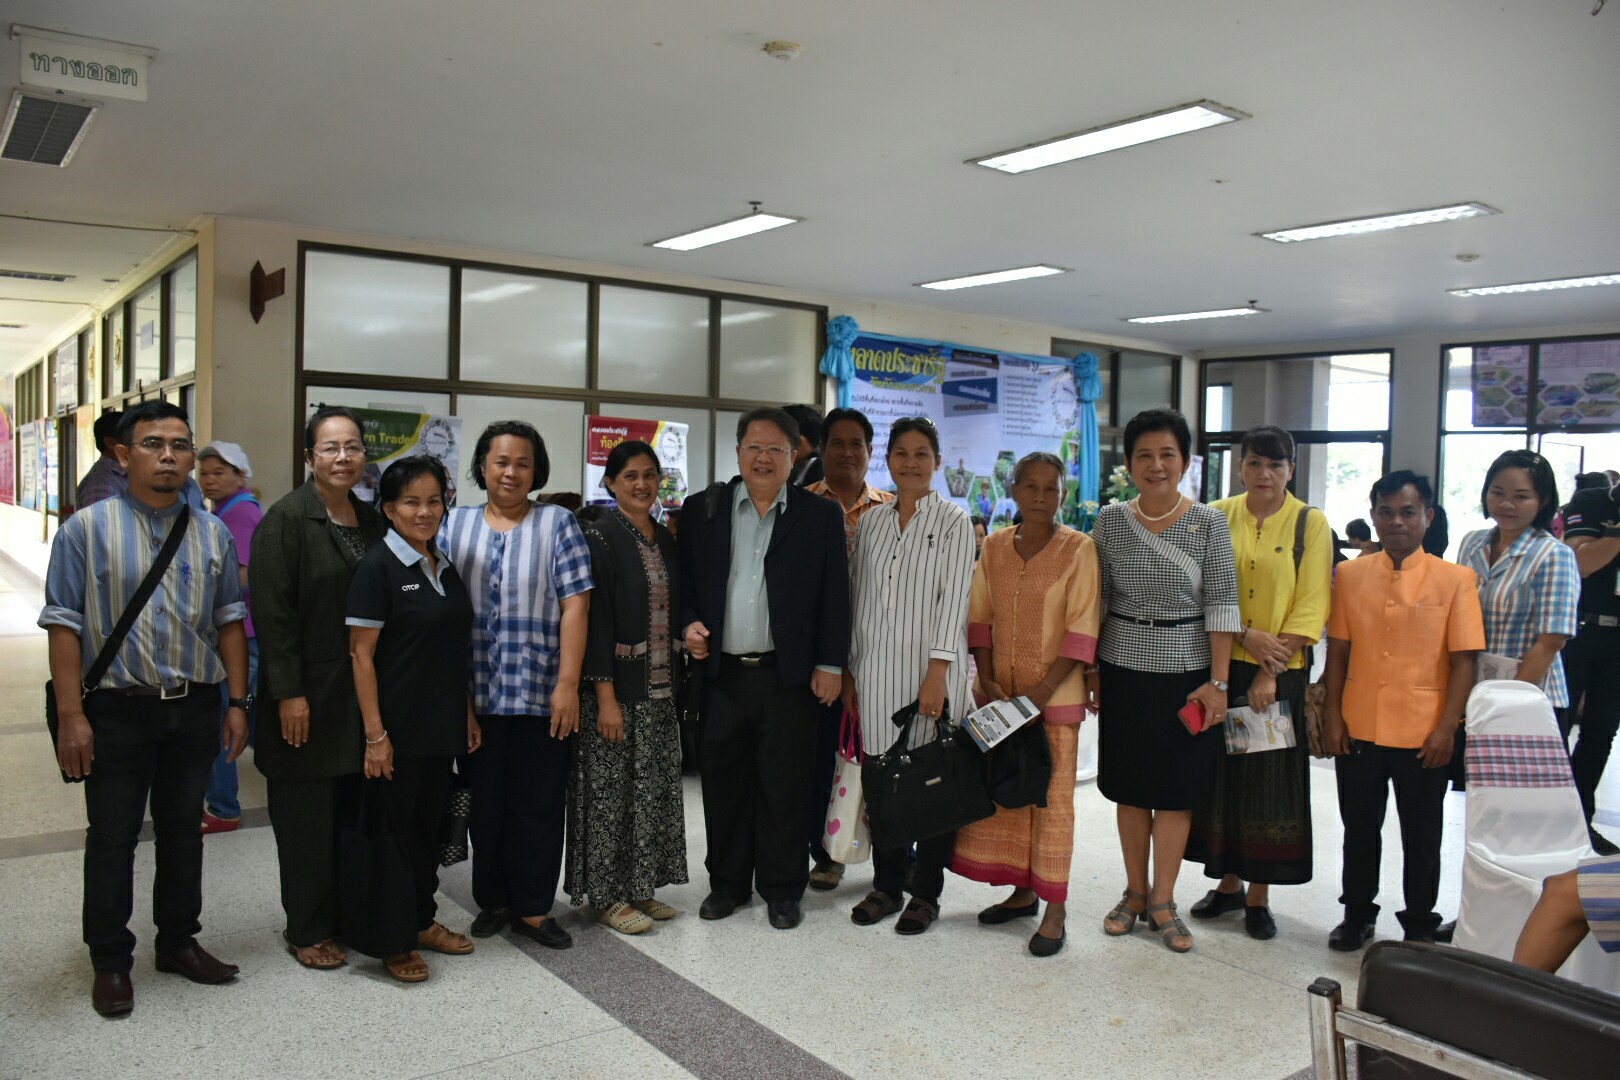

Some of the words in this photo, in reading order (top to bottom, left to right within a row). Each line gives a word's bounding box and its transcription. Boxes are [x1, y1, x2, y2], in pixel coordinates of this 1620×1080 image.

[30, 52, 138, 86] ทางออก
[379, 432, 411, 445] Trade
